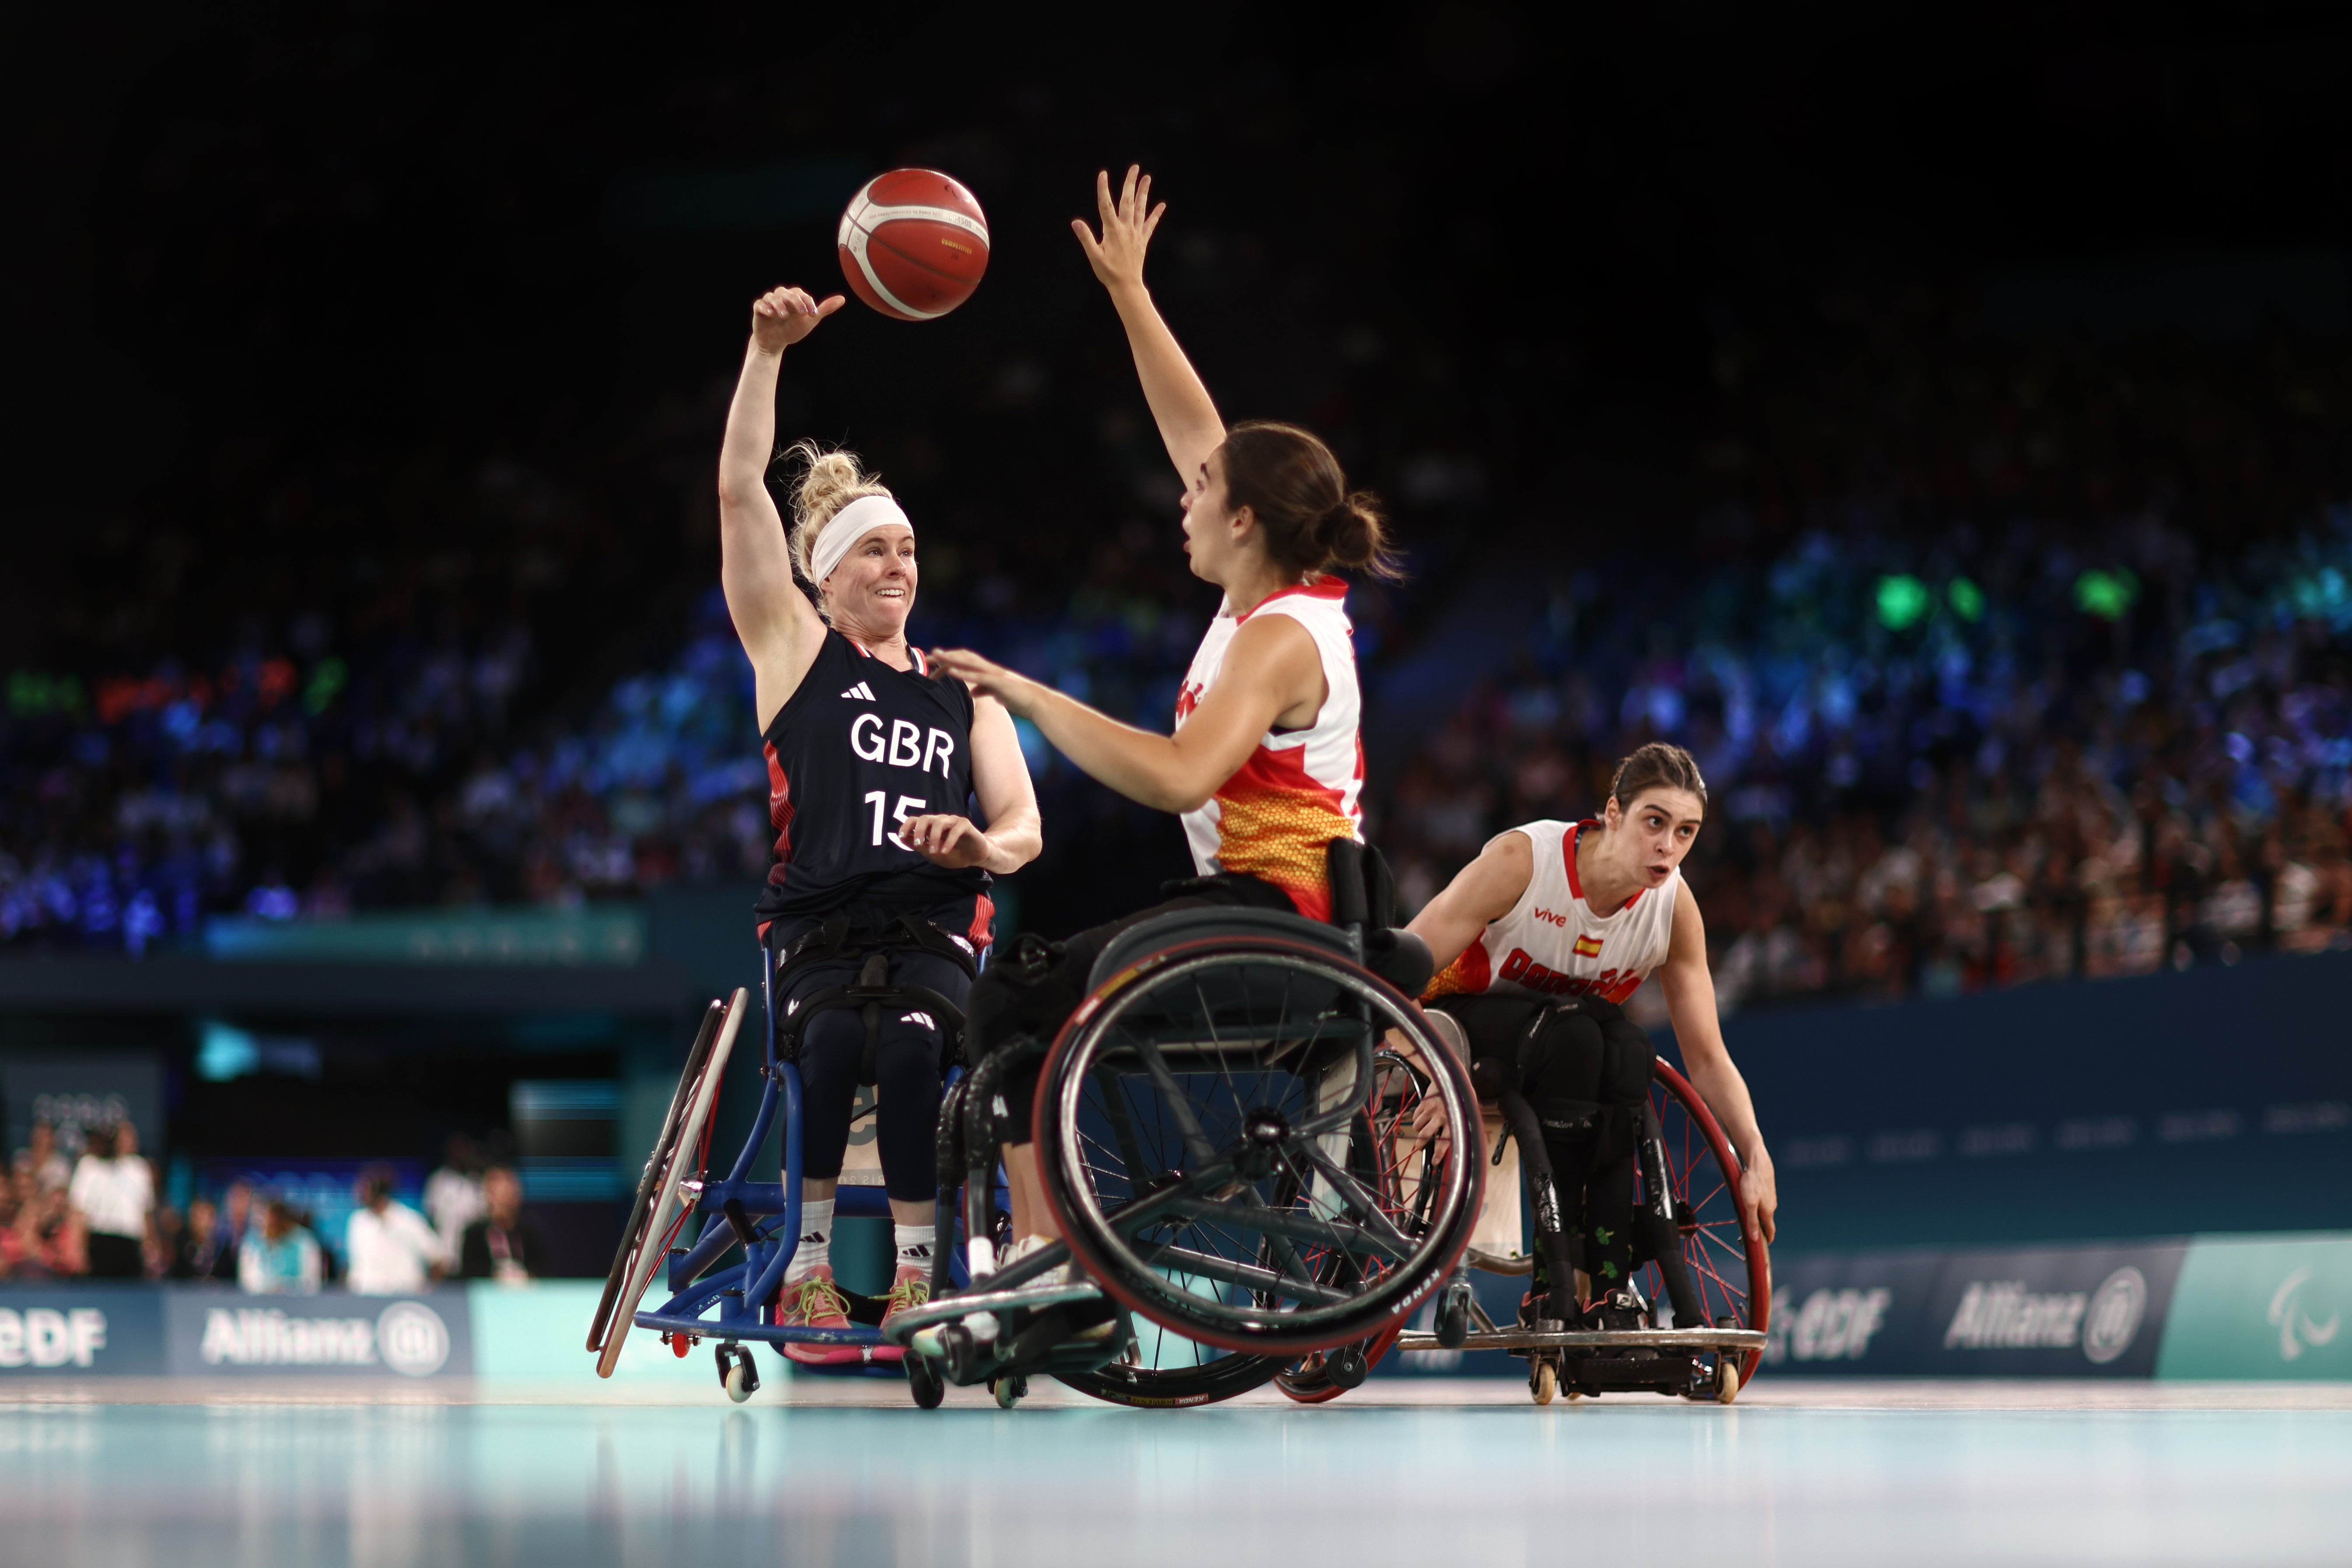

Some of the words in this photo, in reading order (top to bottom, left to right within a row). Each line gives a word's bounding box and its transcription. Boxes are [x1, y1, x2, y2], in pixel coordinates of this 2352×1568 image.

[941, 238, 973, 254] COMPETITION
[851, 712, 954, 779] GBR
[864, 790, 926, 852] 15
[1534, 907, 1567, 928] vive
[1391, 1268, 1440, 1314] KENDA
[1943, 1278, 2088, 1351] Allianz
[200, 1306, 377, 1366] Allianz
[1179, 1396, 1204, 1404] KENDA
